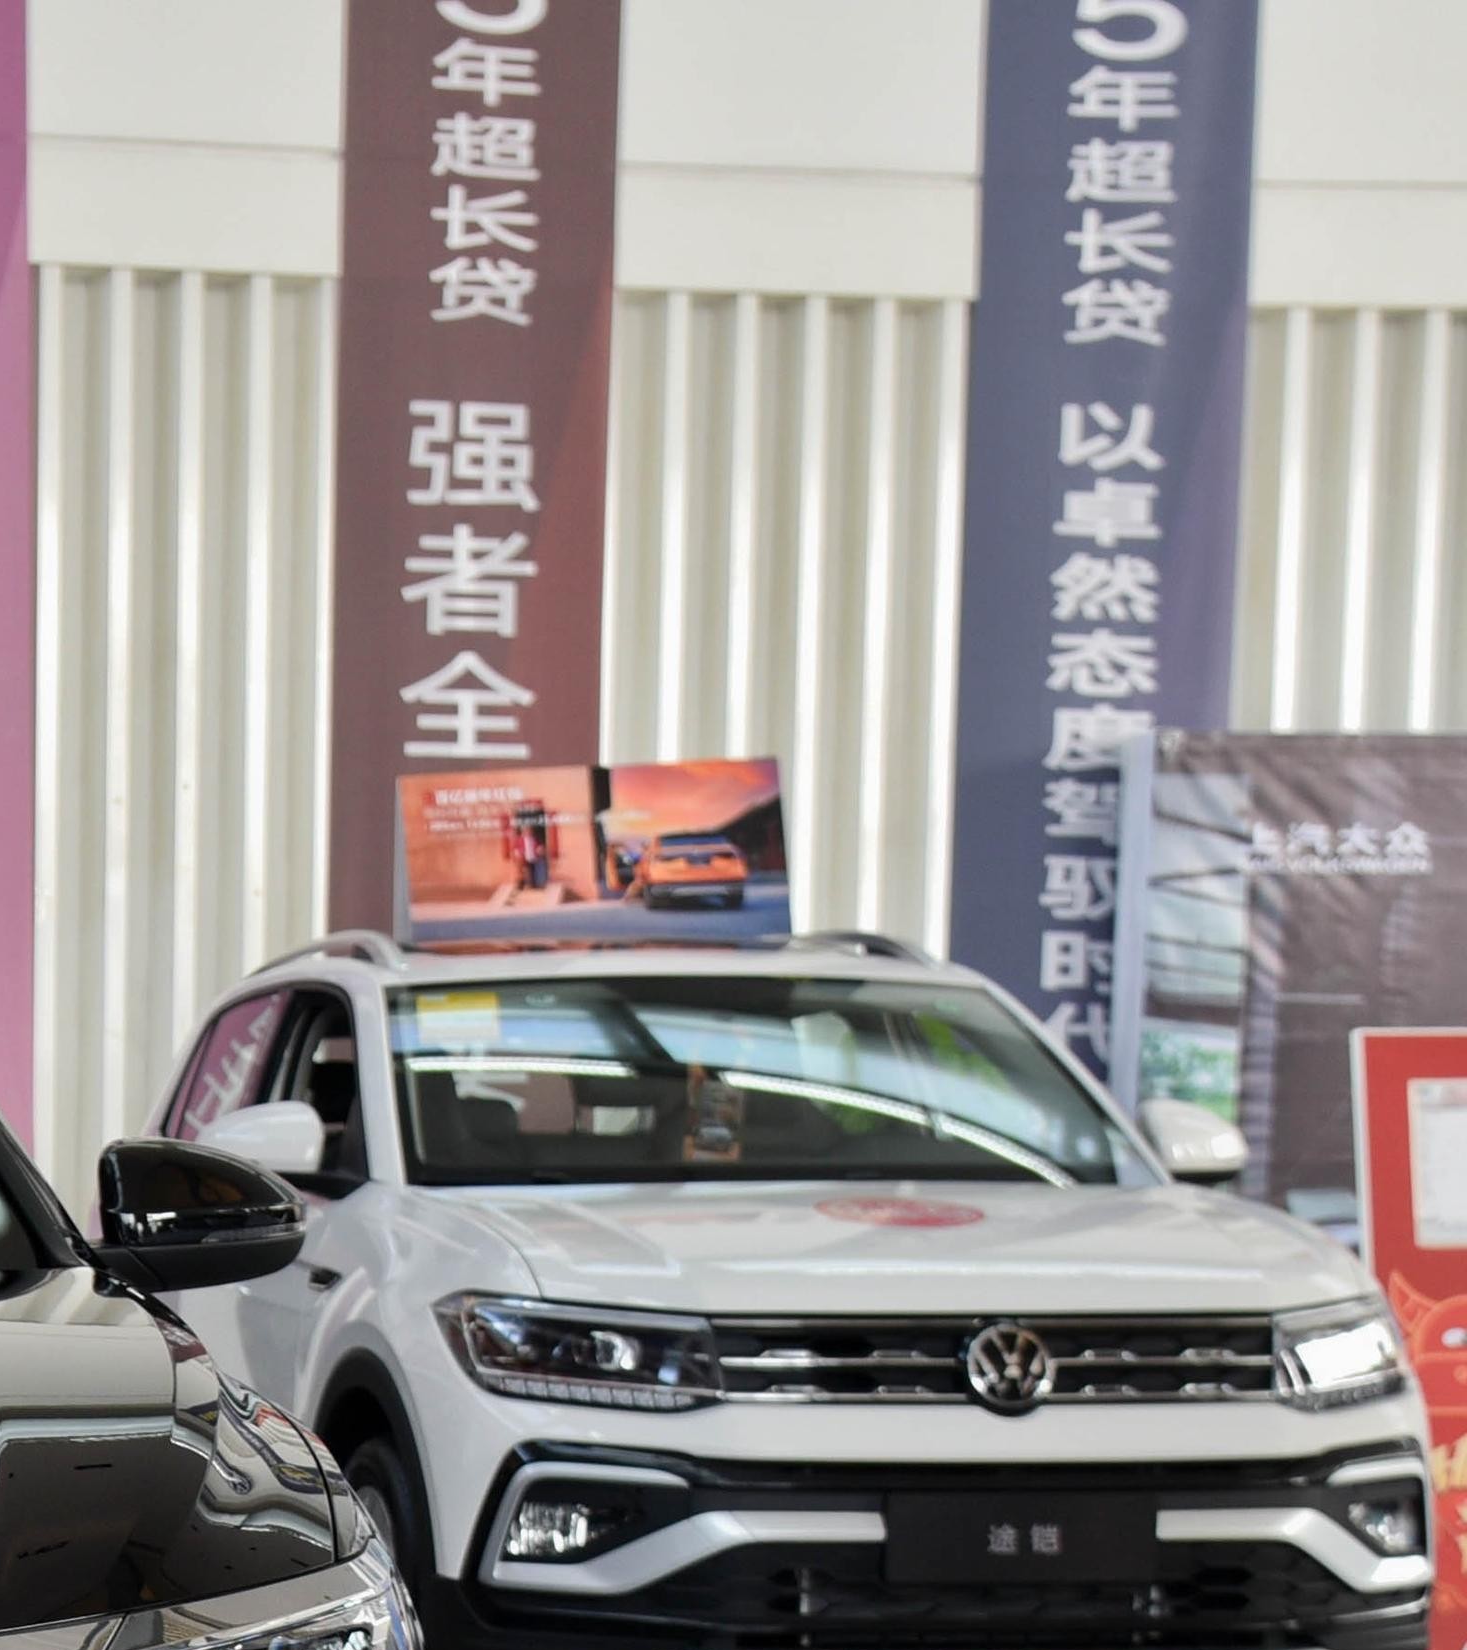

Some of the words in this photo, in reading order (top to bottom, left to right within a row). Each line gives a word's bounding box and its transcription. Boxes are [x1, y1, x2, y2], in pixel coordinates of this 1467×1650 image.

[1060, 0, 1190, 348] 5年超长贷
[399, 399, 541, 760] 强者全
[1251, 821, 1430, 855] 上汽大众
